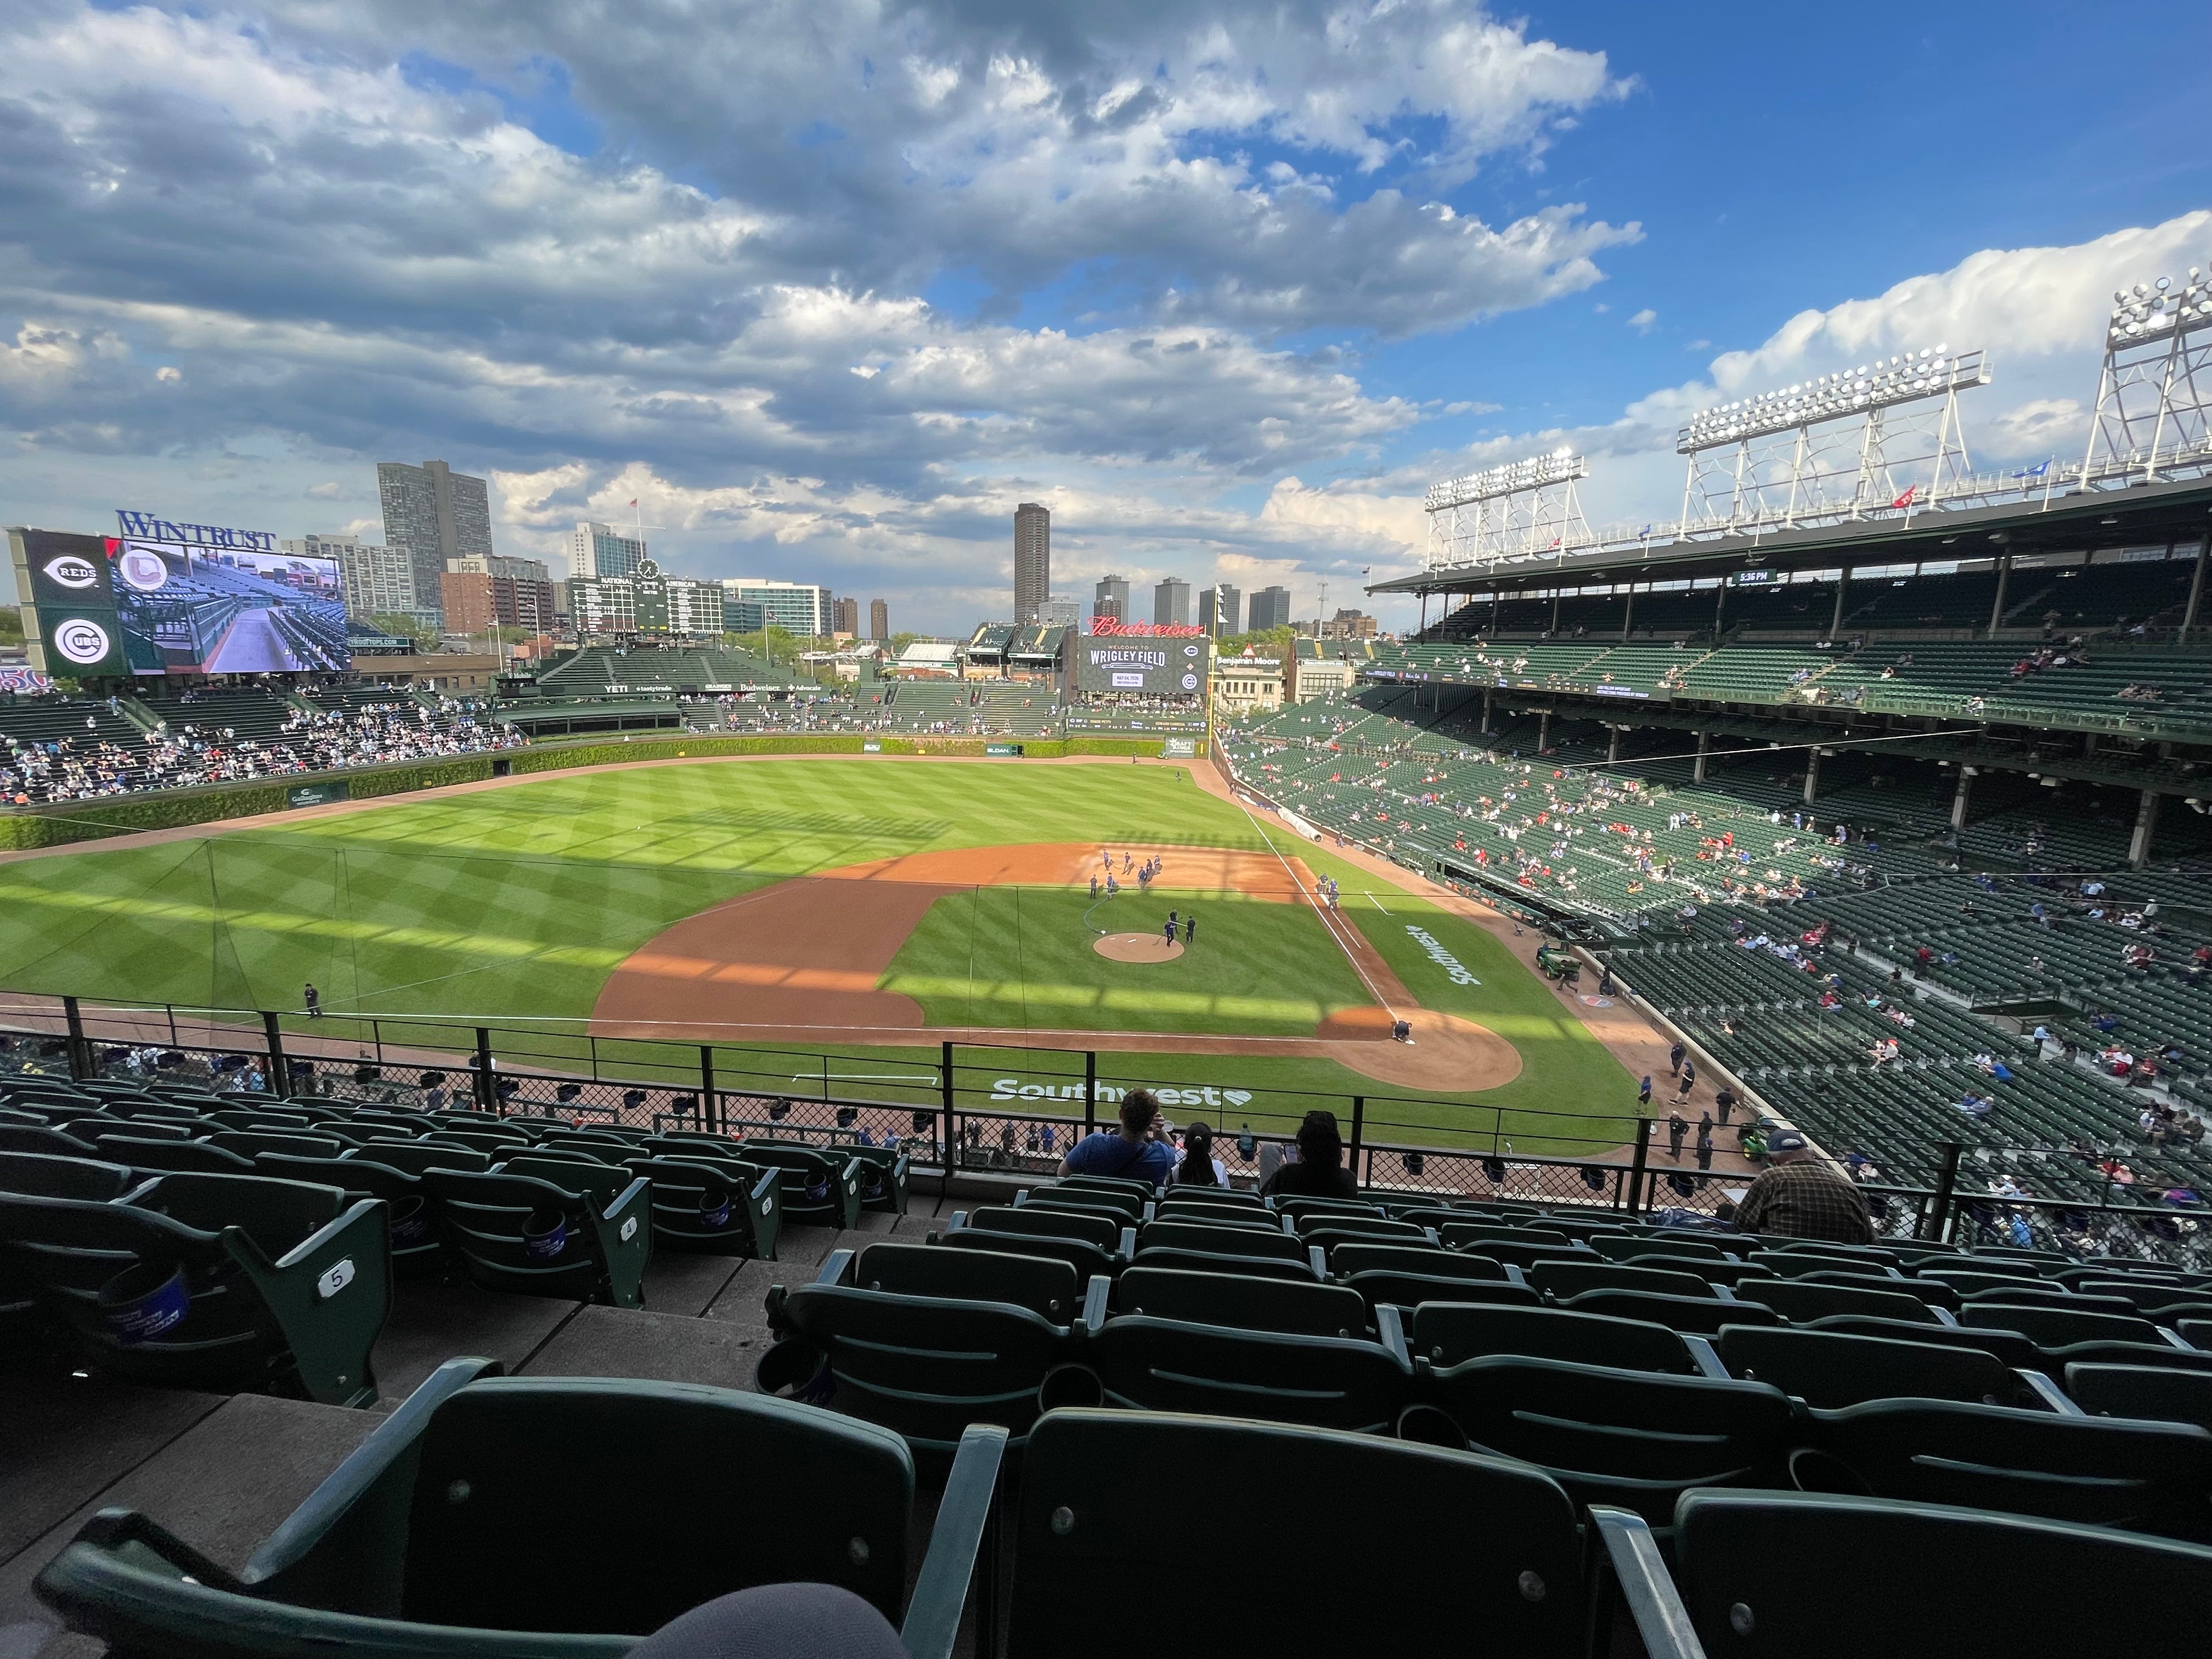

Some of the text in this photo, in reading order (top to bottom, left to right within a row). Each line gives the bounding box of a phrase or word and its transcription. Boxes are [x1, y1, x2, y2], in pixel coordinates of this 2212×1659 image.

[115, 509, 276, 551] WINTRUST
[59, 567, 97, 577] REDS
[1740, 572, 1768, 582] 5:36 PM
[601, 577, 634, 585] NATIONAL
[1087, 616, 1204, 636] Budweiser
[1090, 650, 1165, 667] WRIGLEY FIELD
[1217, 657, 1280, 665] Benjamin Moore
[1407, 932, 1482, 985] Southwest
[627, 1223, 632, 1233] 4
[331, 1269, 343, 1288] 5
